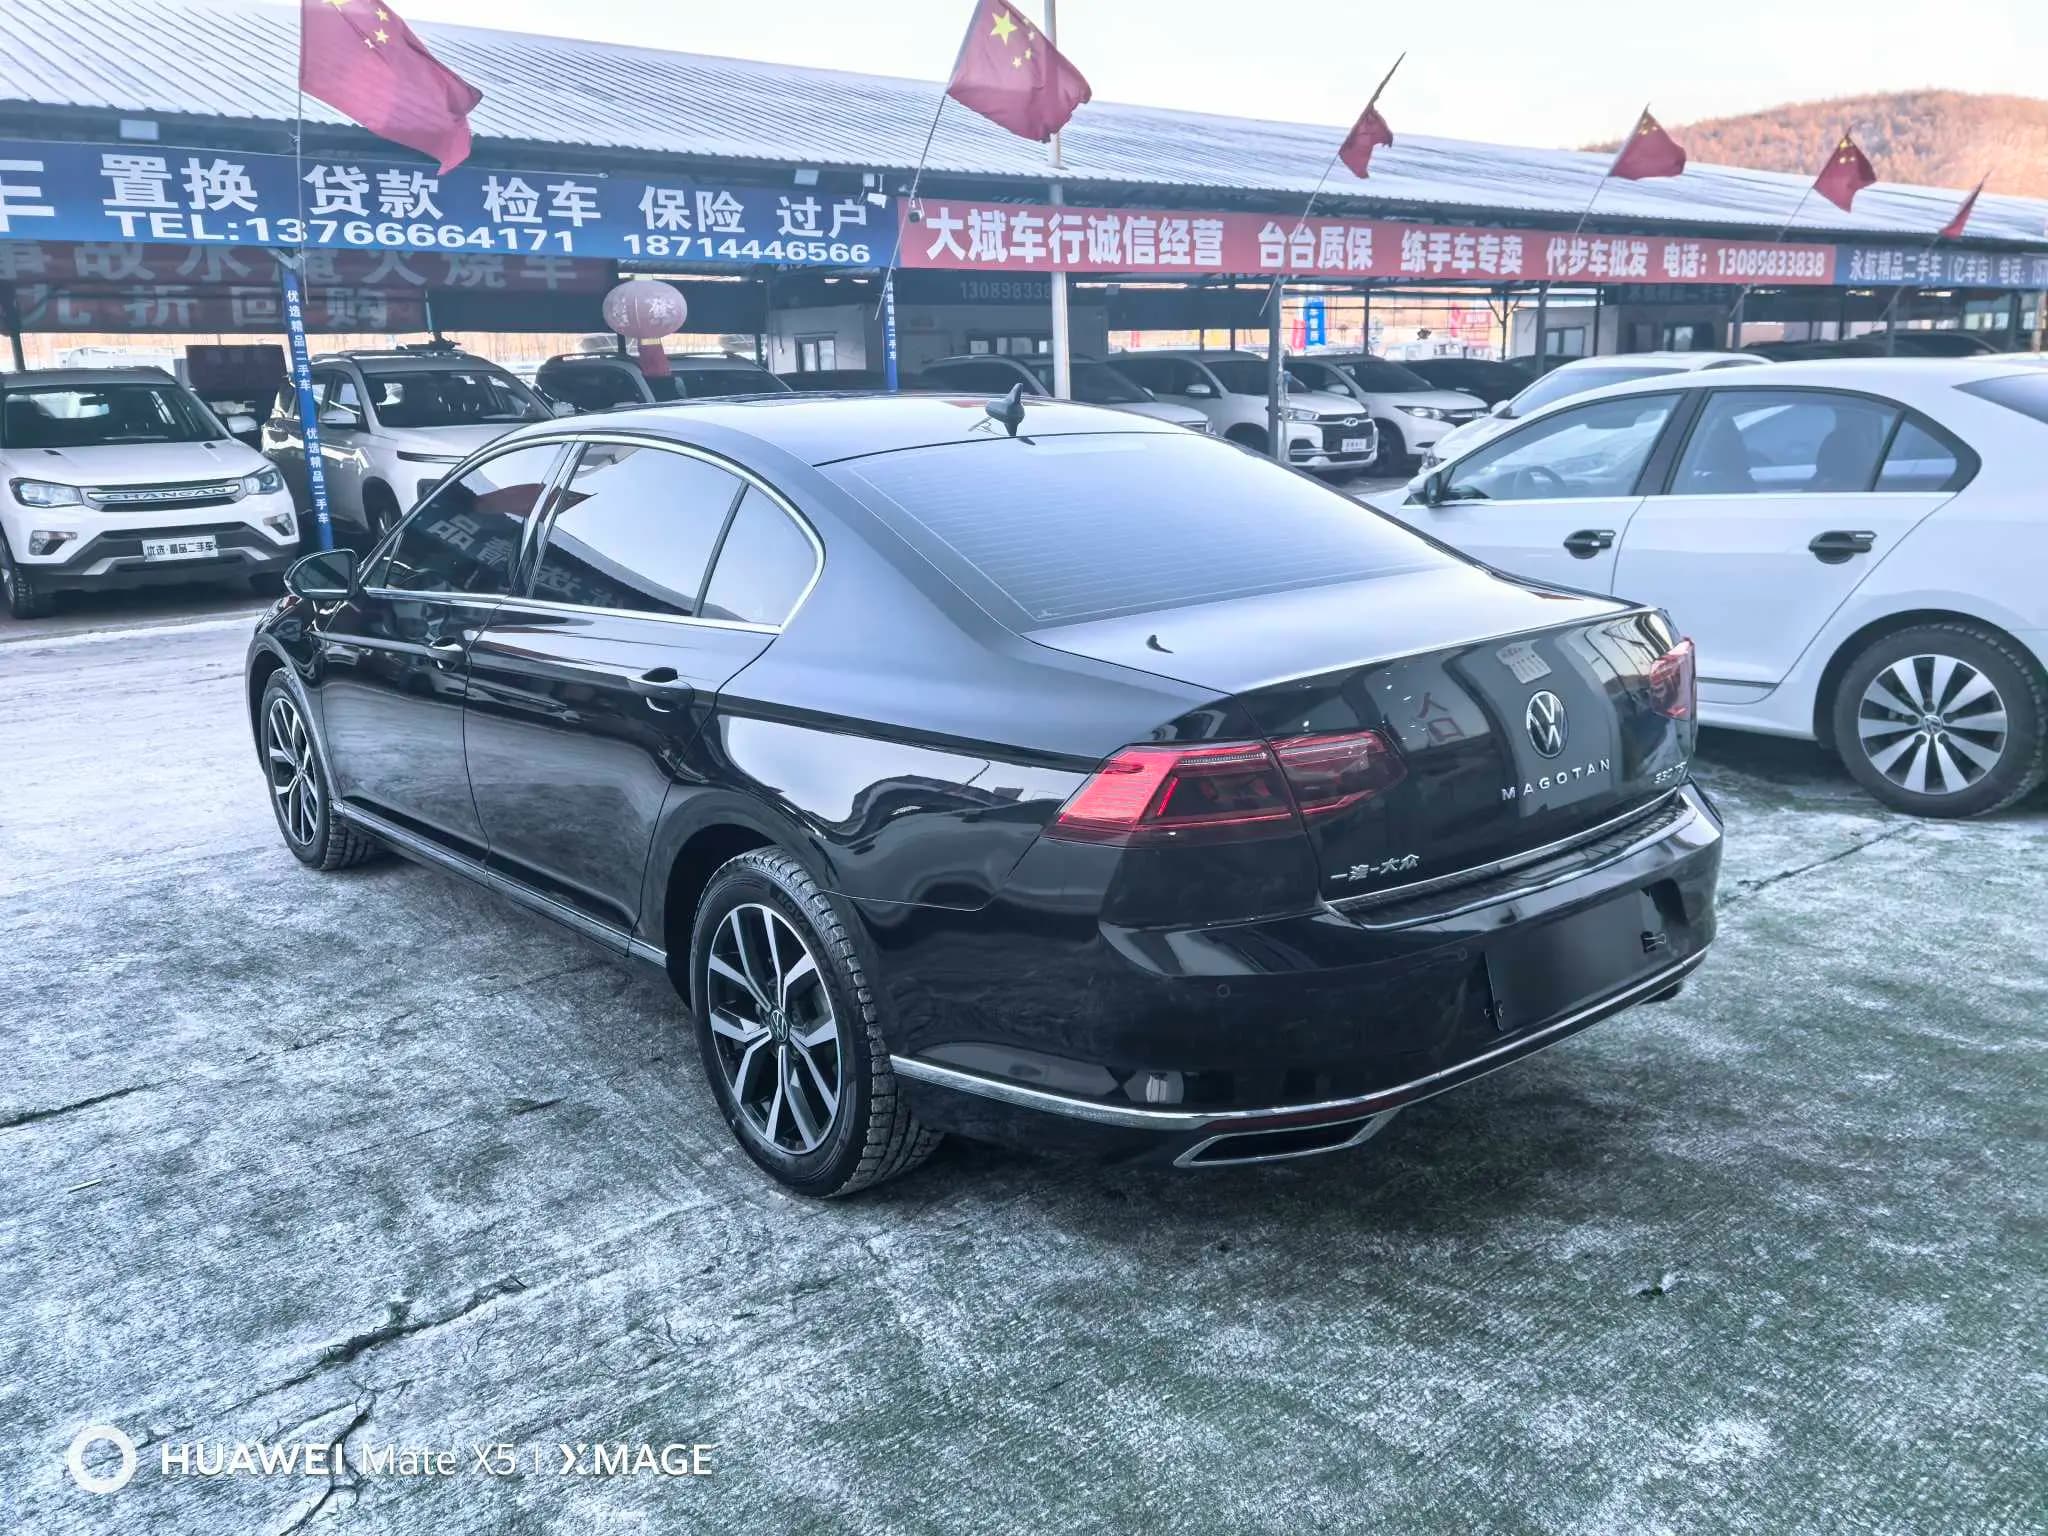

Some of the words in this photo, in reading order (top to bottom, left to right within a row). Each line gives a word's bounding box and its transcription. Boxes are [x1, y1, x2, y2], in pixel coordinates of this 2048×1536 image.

[101, 153, 259, 213] 置换
[304, 163, 444, 220] 贷款
[482, 175, 601, 227] 检车
[638, 185, 745, 234] 保险
[776, 195, 868, 240] 过户
[104, 209, 575, 252] TEL:13766664171
[623, 233, 871, 263] 18714446566
[926, 206, 1225, 267] 大斌车行诚信经营
[1257, 221, 1373, 270] 台台质保
[1400, 229, 1523, 275] 练手车专卖
[1546, 236, 1649, 278] 代步车批发
[105, 487, 227, 500] CHANGAN
[1501, 758, 1610, 801] MAGOTAN
